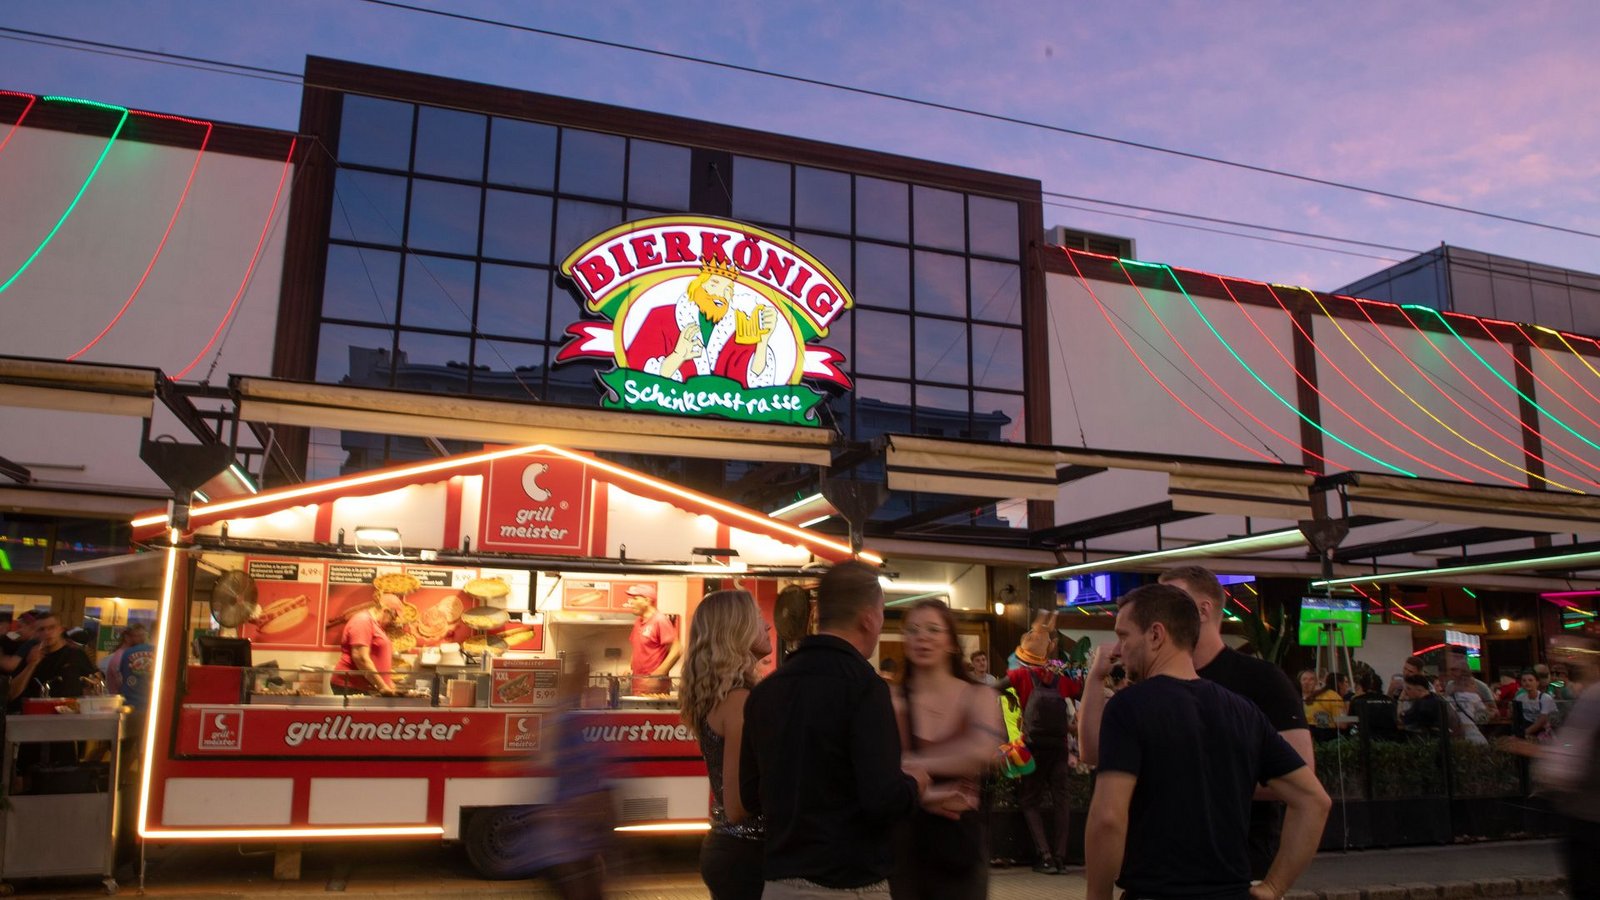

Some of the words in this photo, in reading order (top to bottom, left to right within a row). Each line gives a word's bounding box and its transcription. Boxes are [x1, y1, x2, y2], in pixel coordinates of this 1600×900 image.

[577, 231, 839, 317] BIERKÖNIG
[624, 380, 802, 415] Schinkenstrasse
[515, 507, 555, 525] grill
[500, 523, 568, 540] meister
[496, 672, 509, 681] XXL
[285, 715, 463, 747] grillmeister
